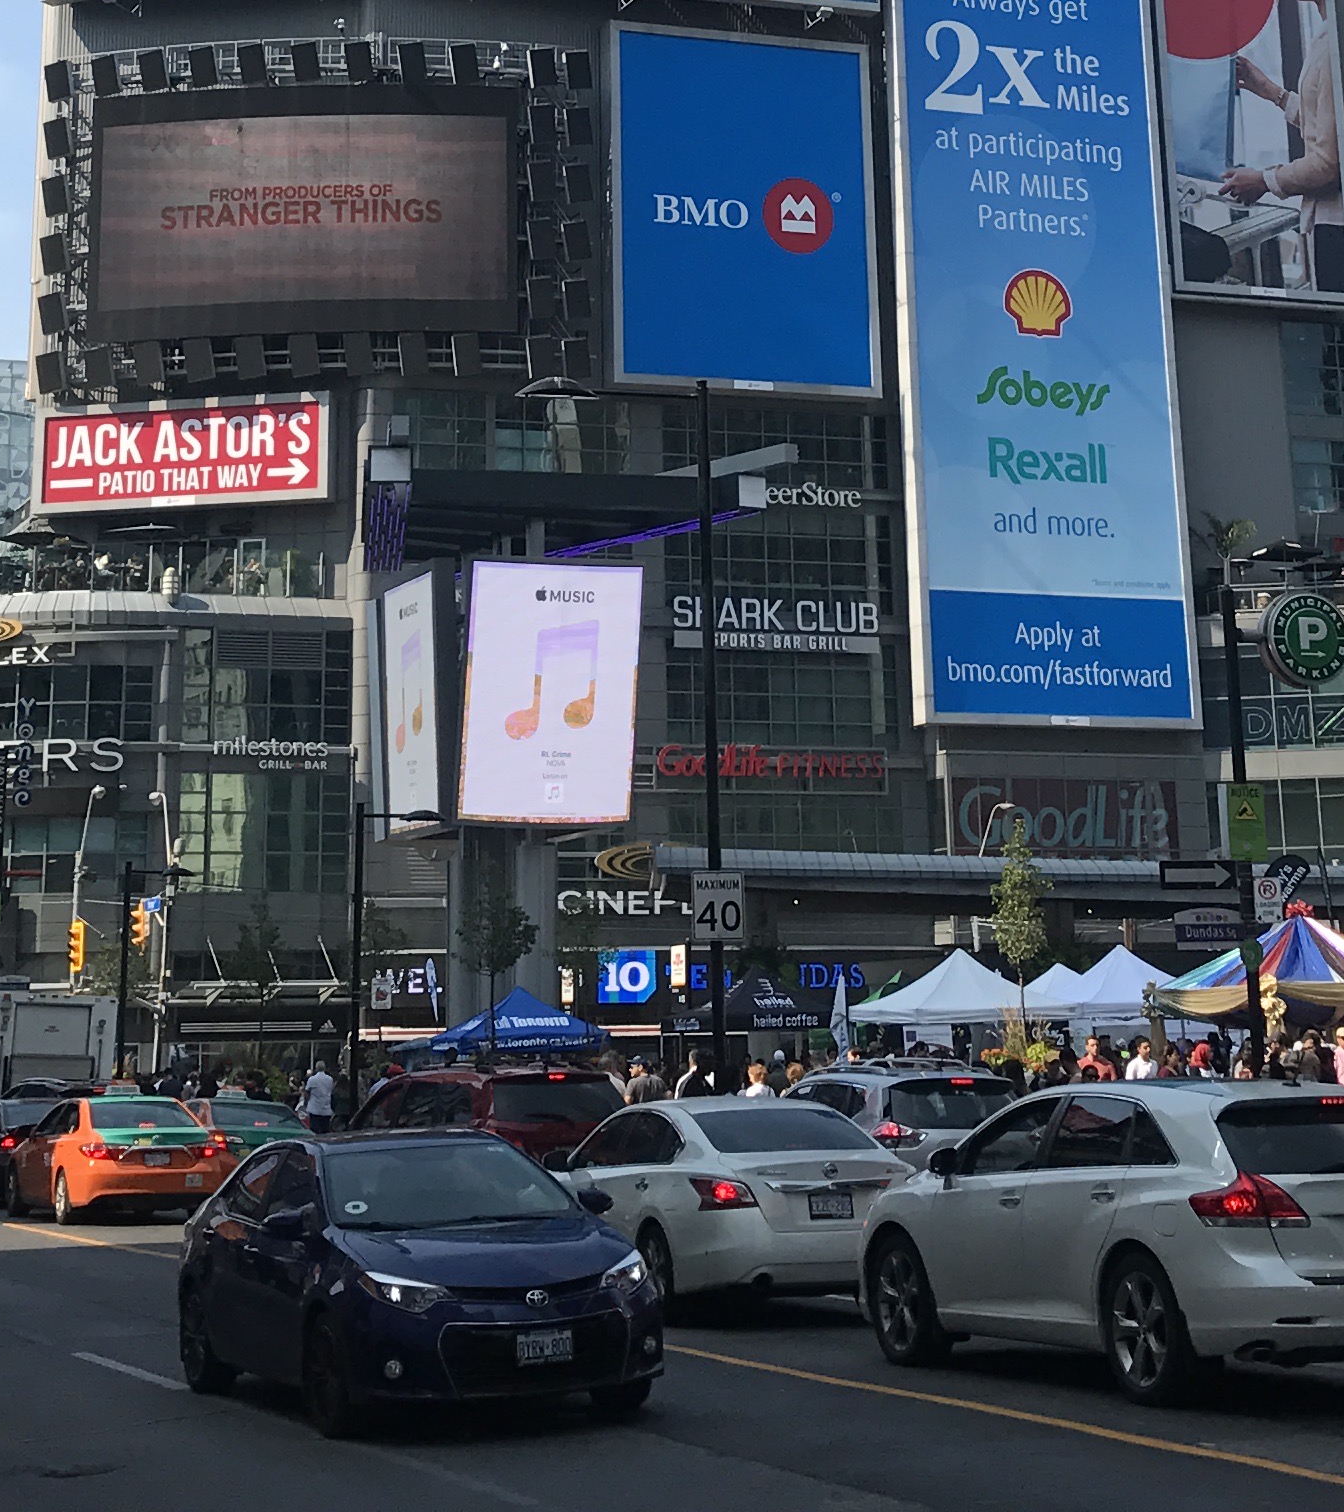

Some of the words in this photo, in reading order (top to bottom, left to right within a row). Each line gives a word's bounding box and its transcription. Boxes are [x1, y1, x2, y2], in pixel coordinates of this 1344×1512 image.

[924, 19, 1052, 116] 2x
[1054, 44, 1101, 78] the
[1056, 83, 1131, 118] Miles
[935, 125, 961, 153] at
[968, 130, 1123, 173] participating
[209, 187, 257, 203] FROM
[262, 183, 365, 201] PRODUCERS
[369, 183, 393, 197] OF
[970, 168, 1011, 195] AIR
[1019, 171, 1090, 203] MILES
[160, 200, 322, 231] STRANGER
[330, 197, 443, 224] THINGS
[652, 192, 750, 231] BMO
[976, 364, 1111, 417] Sobeys
[51, 421, 145, 469] JACK
[153, 412, 312, 463] ASTOR'S
[987, 435, 1110, 486] Rexall
[98, 469, 156, 496] PATIO
[160, 465, 214, 492] THAT
[216, 462, 263, 489] WAY
[765, 481, 862, 508] eerStore
[993, 506, 1039, 536] and
[1047, 511, 1116, 540] more.
[549, 589, 596, 604] MUSIC
[673, 595, 784, 631] SHARK
[796, 600, 879, 634] CLUB
[1276, 597, 1343, 631] MUNICIPAL
[714, 632, 766, 649] SPORTS
[773, 633, 801, 650] BAR
[808, 636, 849, 651] GRILL
[1014, 620, 1074, 650] Apply
[1081, 623, 1101, 648] at
[1297, 615, 1329, 650] P
[946, 659, 1173, 690] bmo.com/fastforward
[13, 696, 37, 809] Yonge
[212, 734, 329, 757] milestones
[258, 759, 292, 770] GRILL
[304, 760, 328, 770] BAR
[777, 751, 886, 779] FITNESS
[1230, 787, 1260, 798] NOTICE
[696, 878, 740, 891] MAXIMUM
[696, 899, 742, 933] 40
[1185, 925, 1224, 939] Dundas
[1226, 926, 1237, 939] Sq
[603, 960, 651, 993] 10
[510, 1015, 570, 1028] TORONTO
[753, 1014, 784, 1028] hailed
[785, 1014, 819, 1027] coffee
